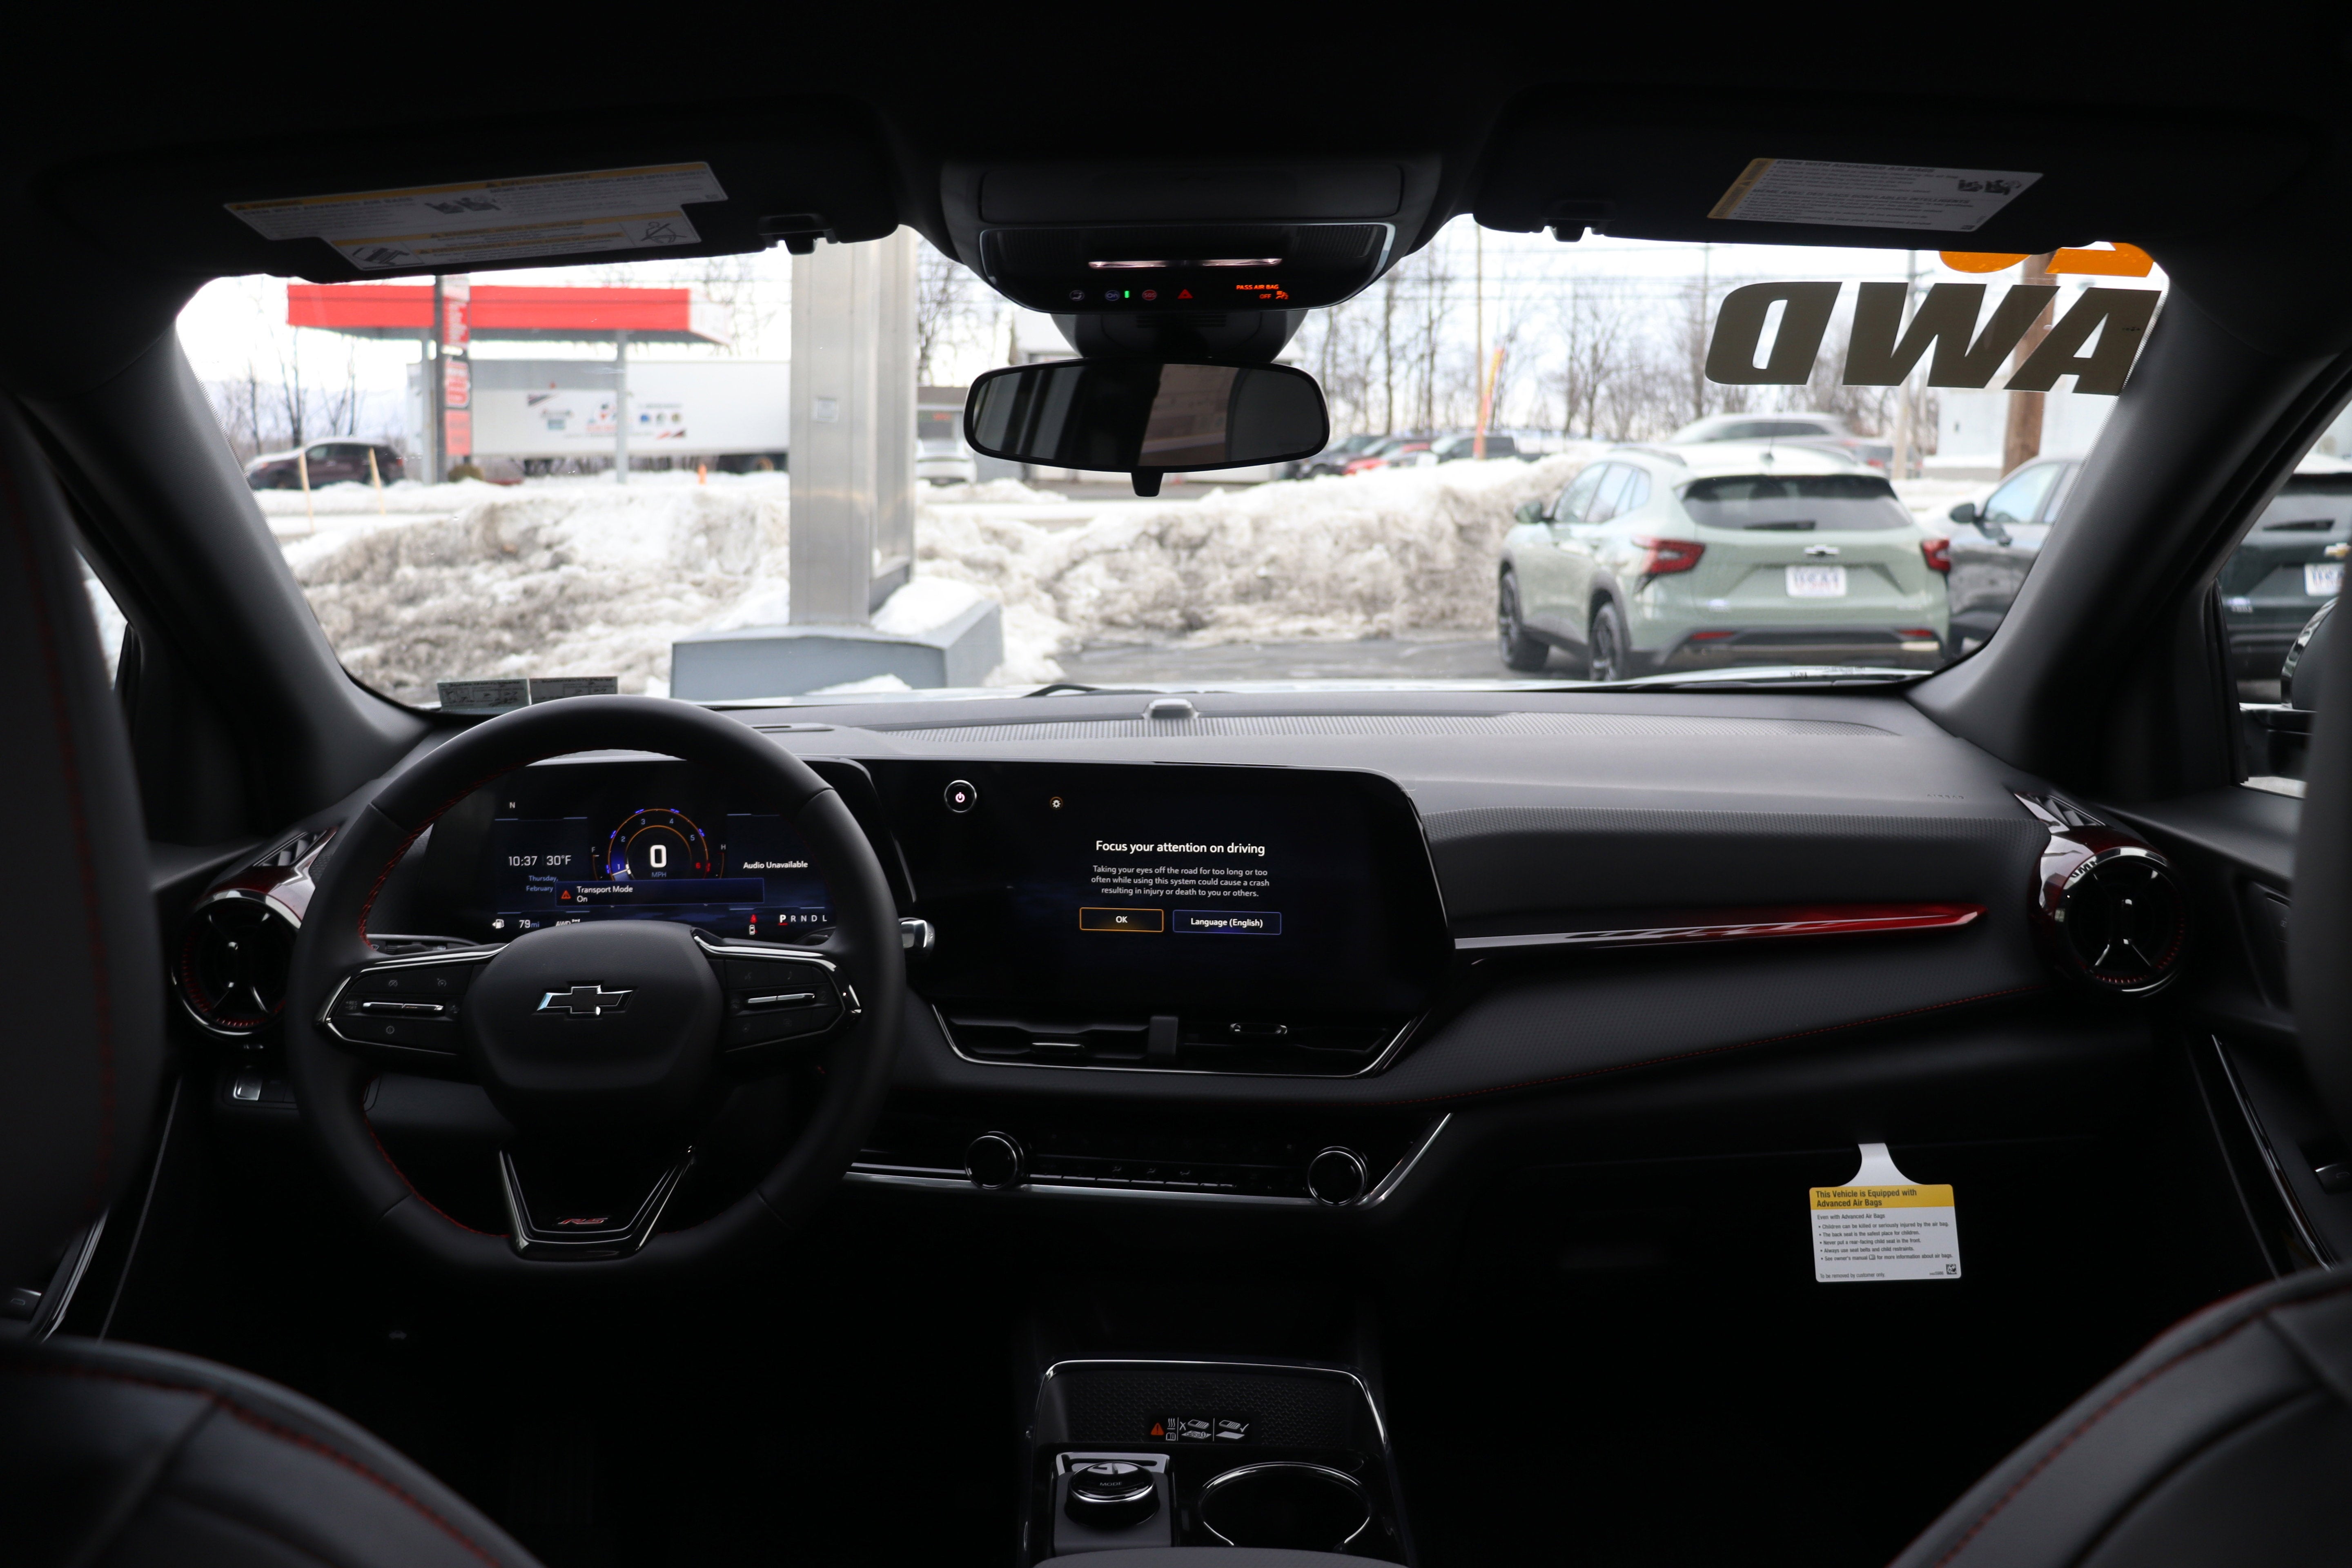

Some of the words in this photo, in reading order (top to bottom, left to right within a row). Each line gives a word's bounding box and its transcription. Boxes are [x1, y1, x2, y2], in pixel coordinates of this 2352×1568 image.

[1096, 840, 1128, 851] Focus
[1129, 844, 1155, 854] your
[1156, 842, 1207, 853] attention
[1227, 842, 1265, 857] driving
[508, 856, 538, 866] 10:37
[546, 855, 572, 866] 30°F
[650, 844, 667, 868] 0
[1093, 865, 1117, 875] Taking
[1226, 868, 1243, 877] long
[1133, 877, 1153, 886] using
[1170, 878, 1196, 886] system
[577, 886, 611, 894] Transport
[1101, 886, 1133, 896] resulting
[1143, 887, 1164, 897] injury
[780, 915, 786, 923] P
[1191, 918, 1228, 928] Language
[1229, 918, 1263, 928] (English)
[1868, 1189, 1900, 1198] Equipped
[1864, 1198, 1882, 1207] Bags
